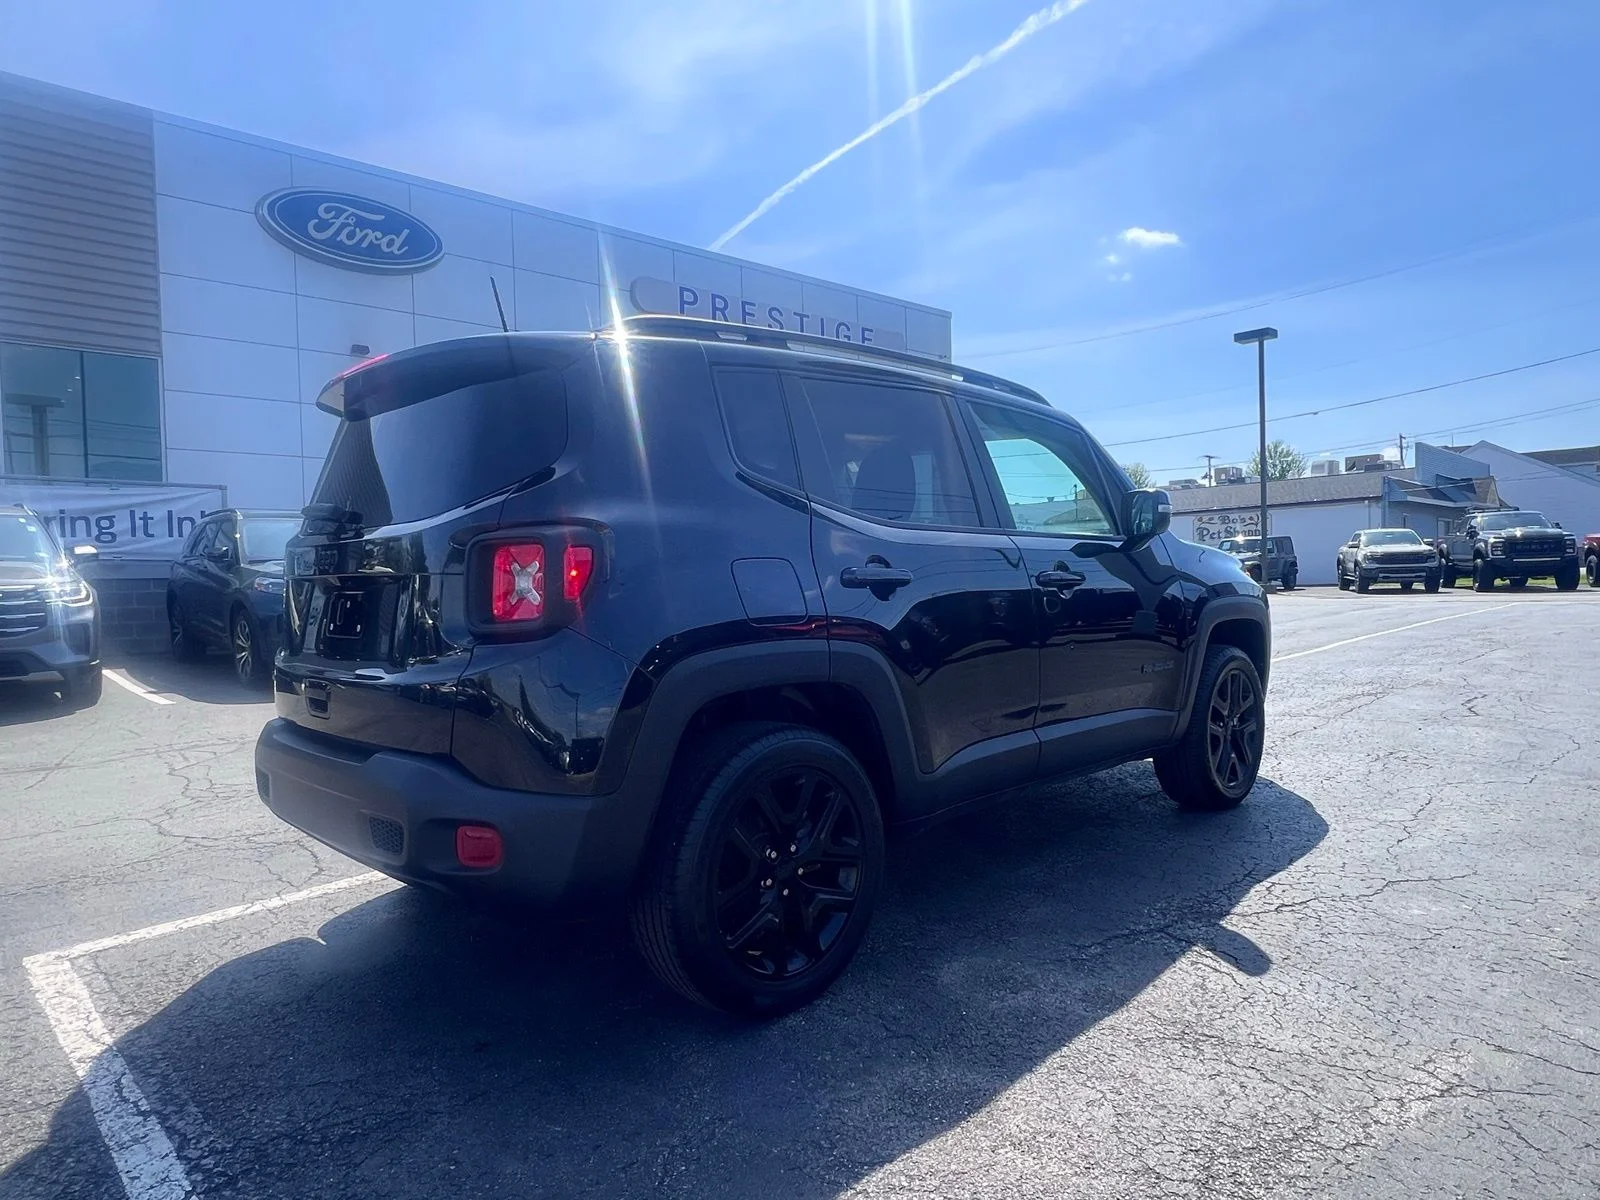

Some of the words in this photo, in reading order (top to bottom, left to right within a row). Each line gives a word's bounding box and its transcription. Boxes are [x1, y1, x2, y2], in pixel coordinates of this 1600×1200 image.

[307, 202, 409, 256] Ford
[678, 286, 875, 344] PRESTIGE
[43, 509, 118, 544] ring
[130, 509, 155, 538] It
[1196, 526, 1222, 541] Pet
